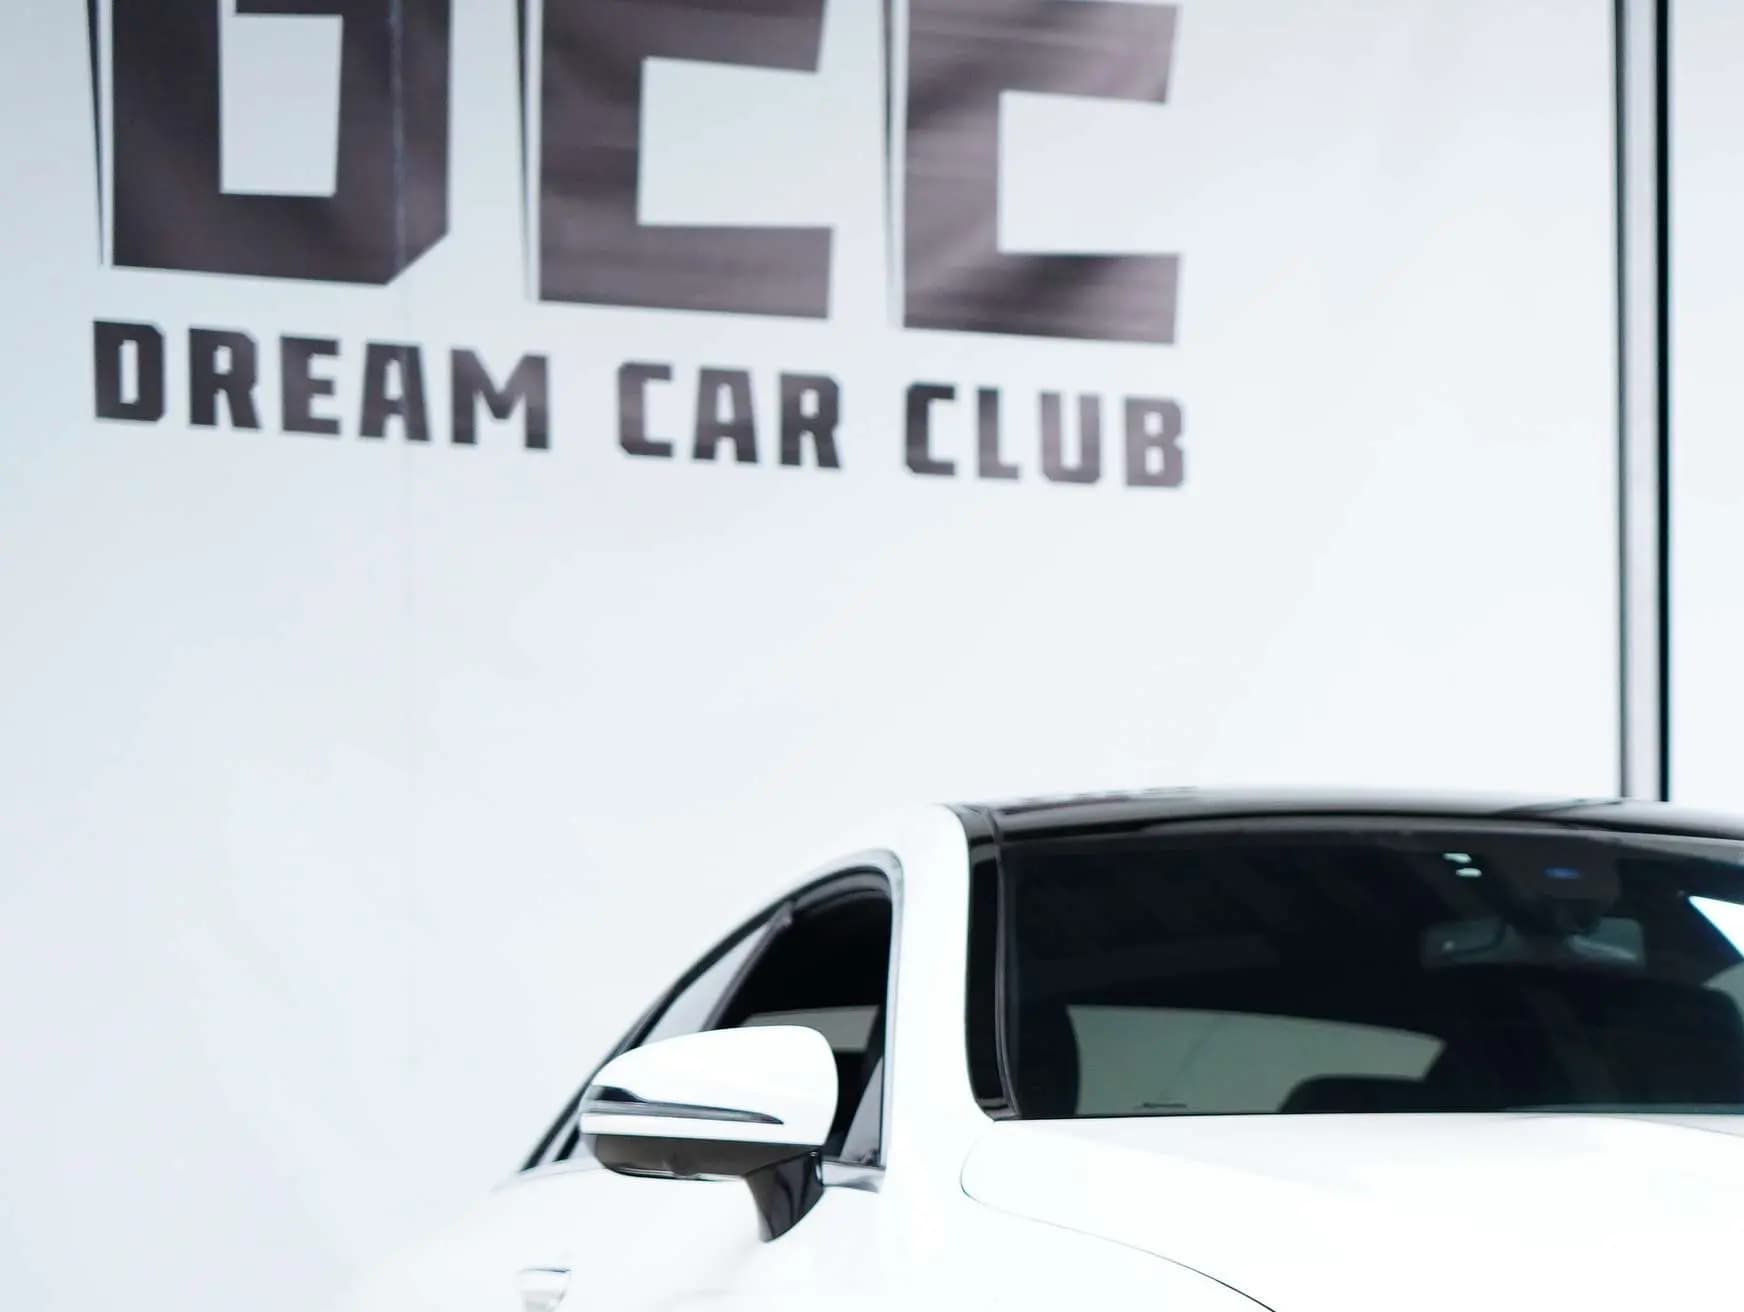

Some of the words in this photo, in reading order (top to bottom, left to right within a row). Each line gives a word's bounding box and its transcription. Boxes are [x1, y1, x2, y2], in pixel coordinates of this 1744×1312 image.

[93, 319, 550, 450] DREAM
[618, 361, 843, 470] CAR
[904, 381, 1186, 489] CLUB
